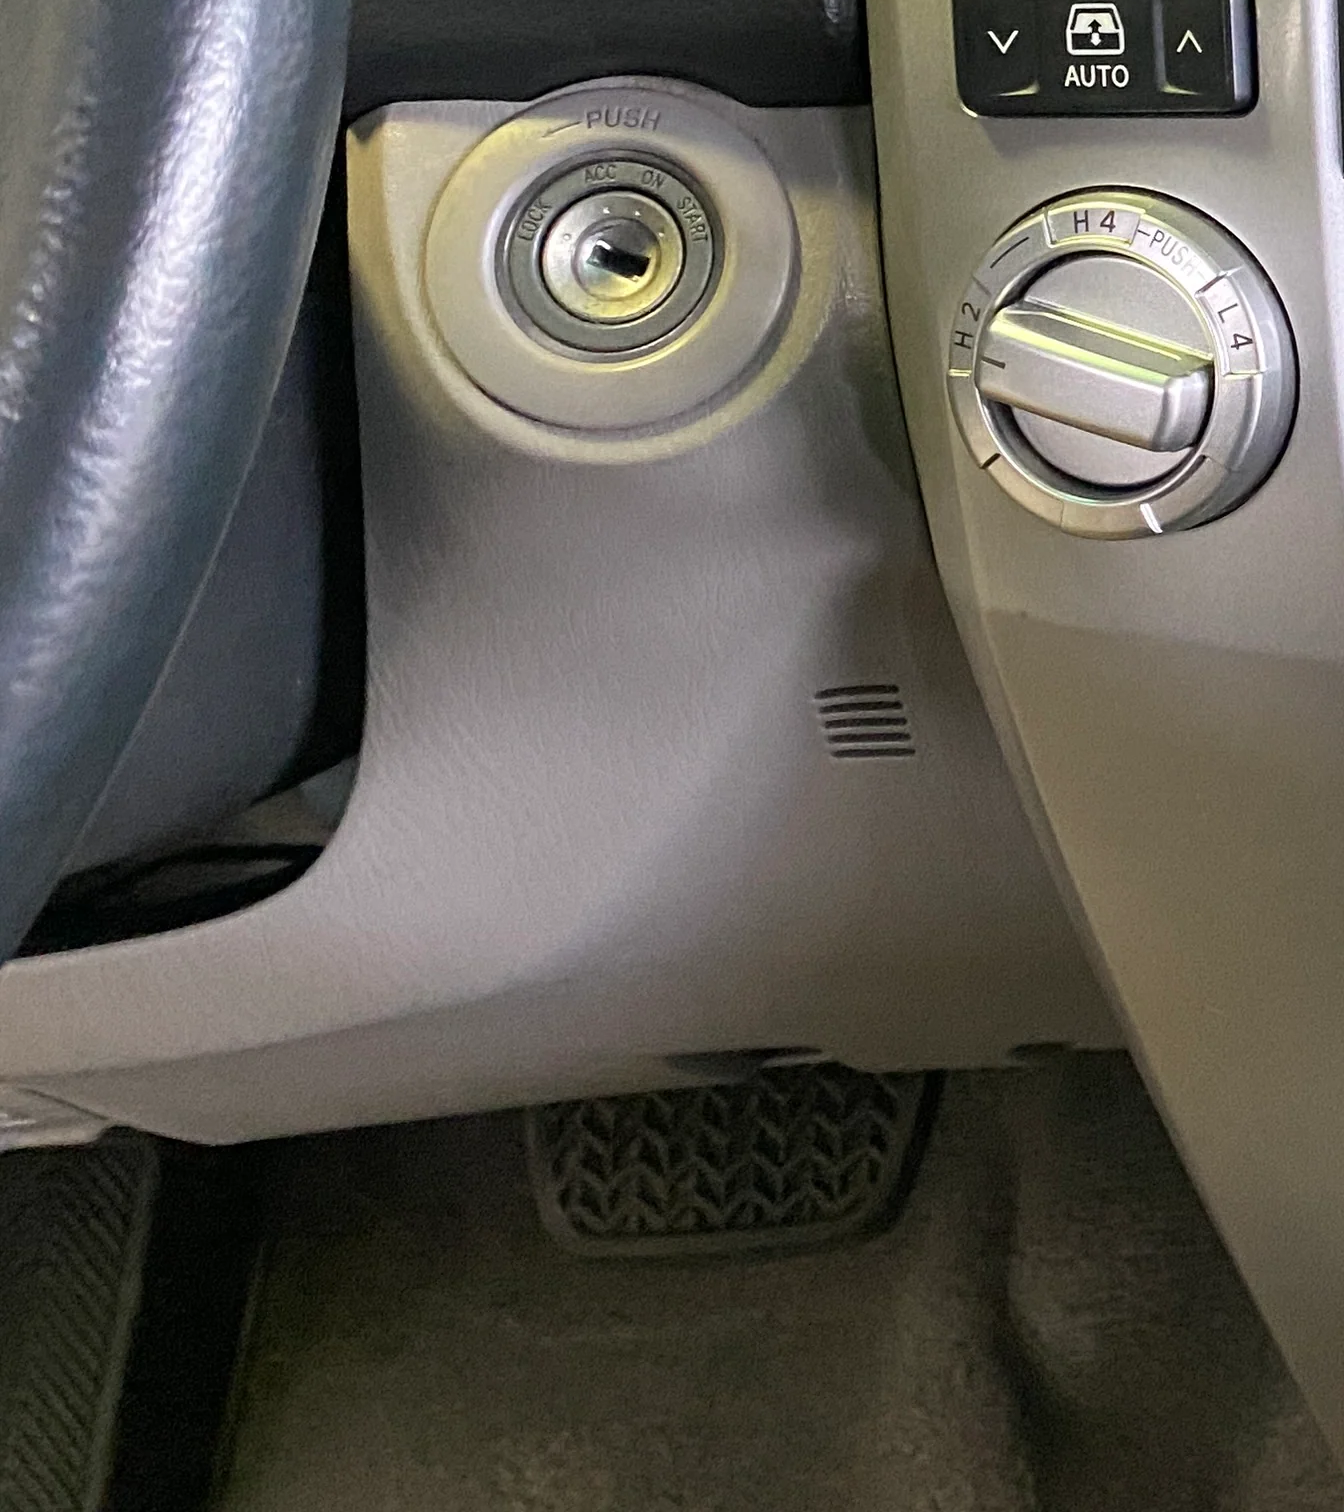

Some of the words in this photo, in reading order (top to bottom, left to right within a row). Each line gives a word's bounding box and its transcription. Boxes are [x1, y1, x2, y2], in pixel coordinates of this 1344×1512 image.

[1064, 64, 1129, 88] AUTO
[584, 107, 661, 132] PUSH
[584, 165, 617, 183] ACC
[517, 200, 551, 242] LOCK
[676, 196, 709, 244] START
